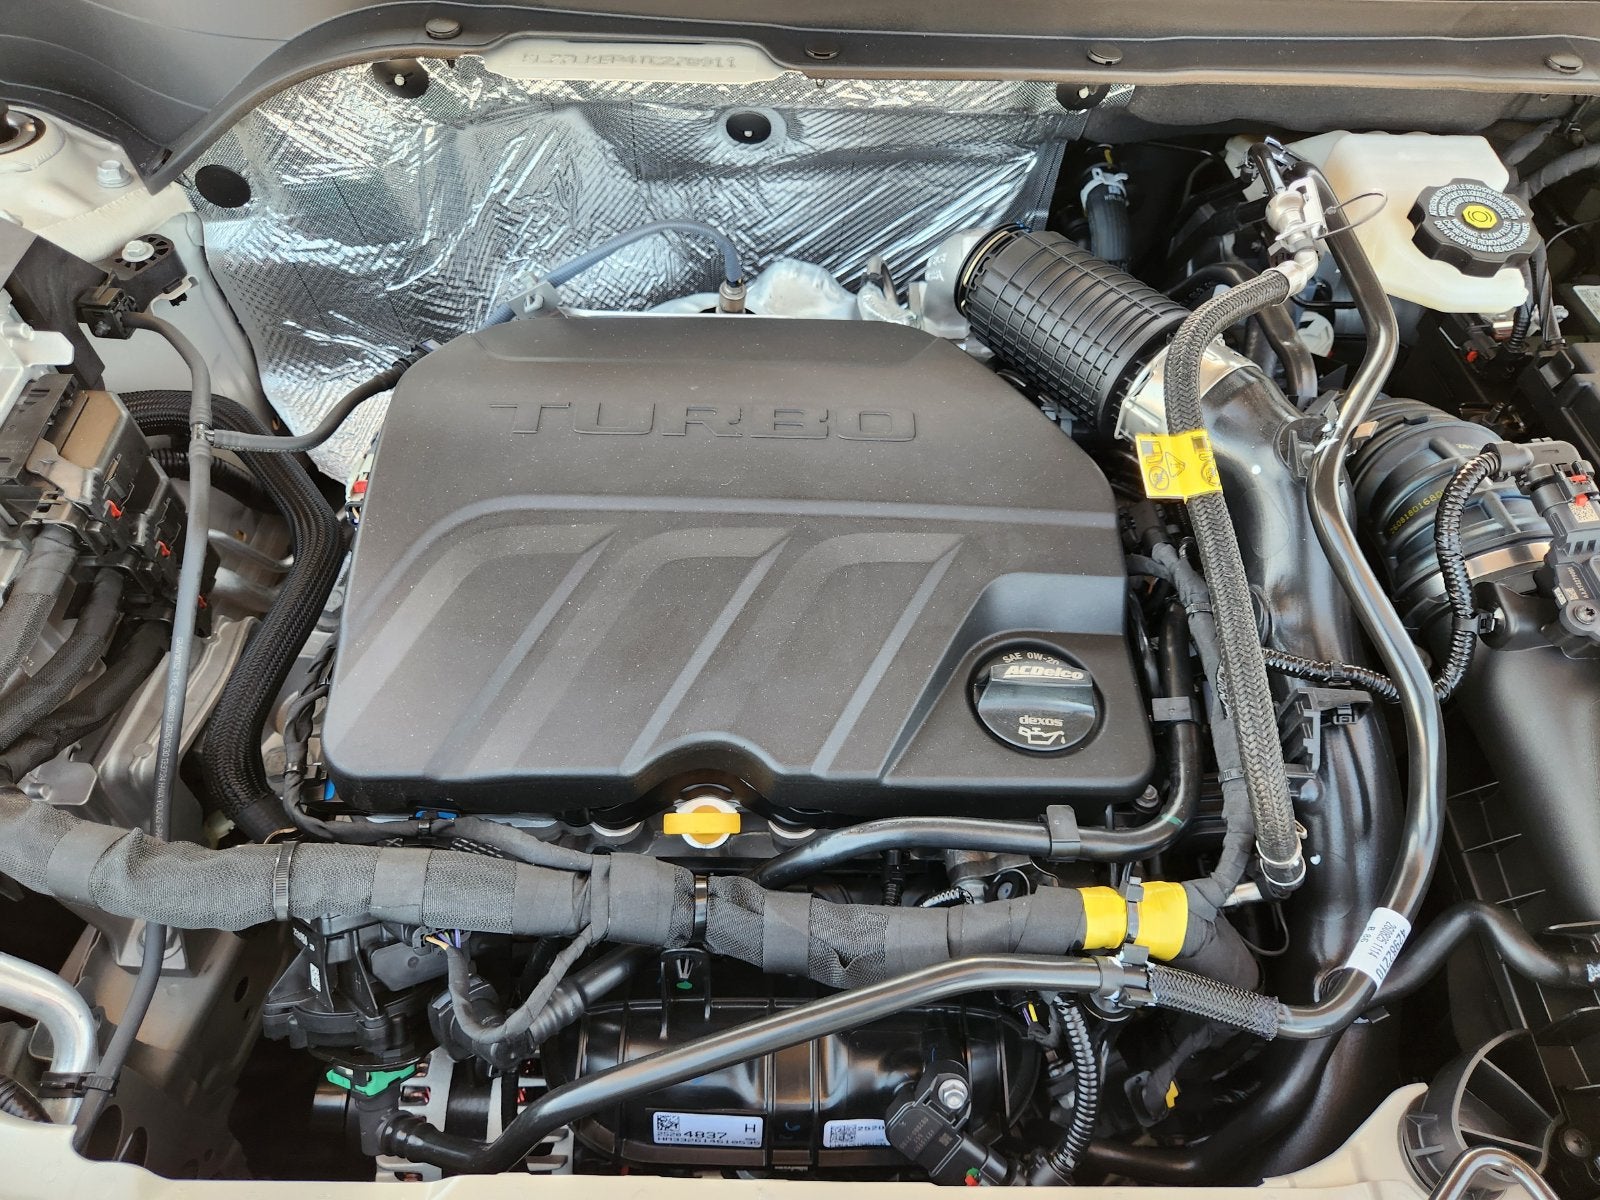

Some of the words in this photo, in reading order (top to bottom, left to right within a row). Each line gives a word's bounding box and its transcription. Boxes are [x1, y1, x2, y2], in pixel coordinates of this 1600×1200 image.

[1447, 232, 1467, 245] FLUID
[1467, 242, 1487, 251] FROM
[1493, 242, 1517, 252] SEALED
[490, 402, 917, 442] TURBO
[1002, 652, 1023, 663] SAE
[1003, 665, 1084, 681] ACDelco
[1018, 715, 1064, 726] dexos
[1375, 928, 1406, 980] 42982210
[745, 1123, 756, 1133] H
